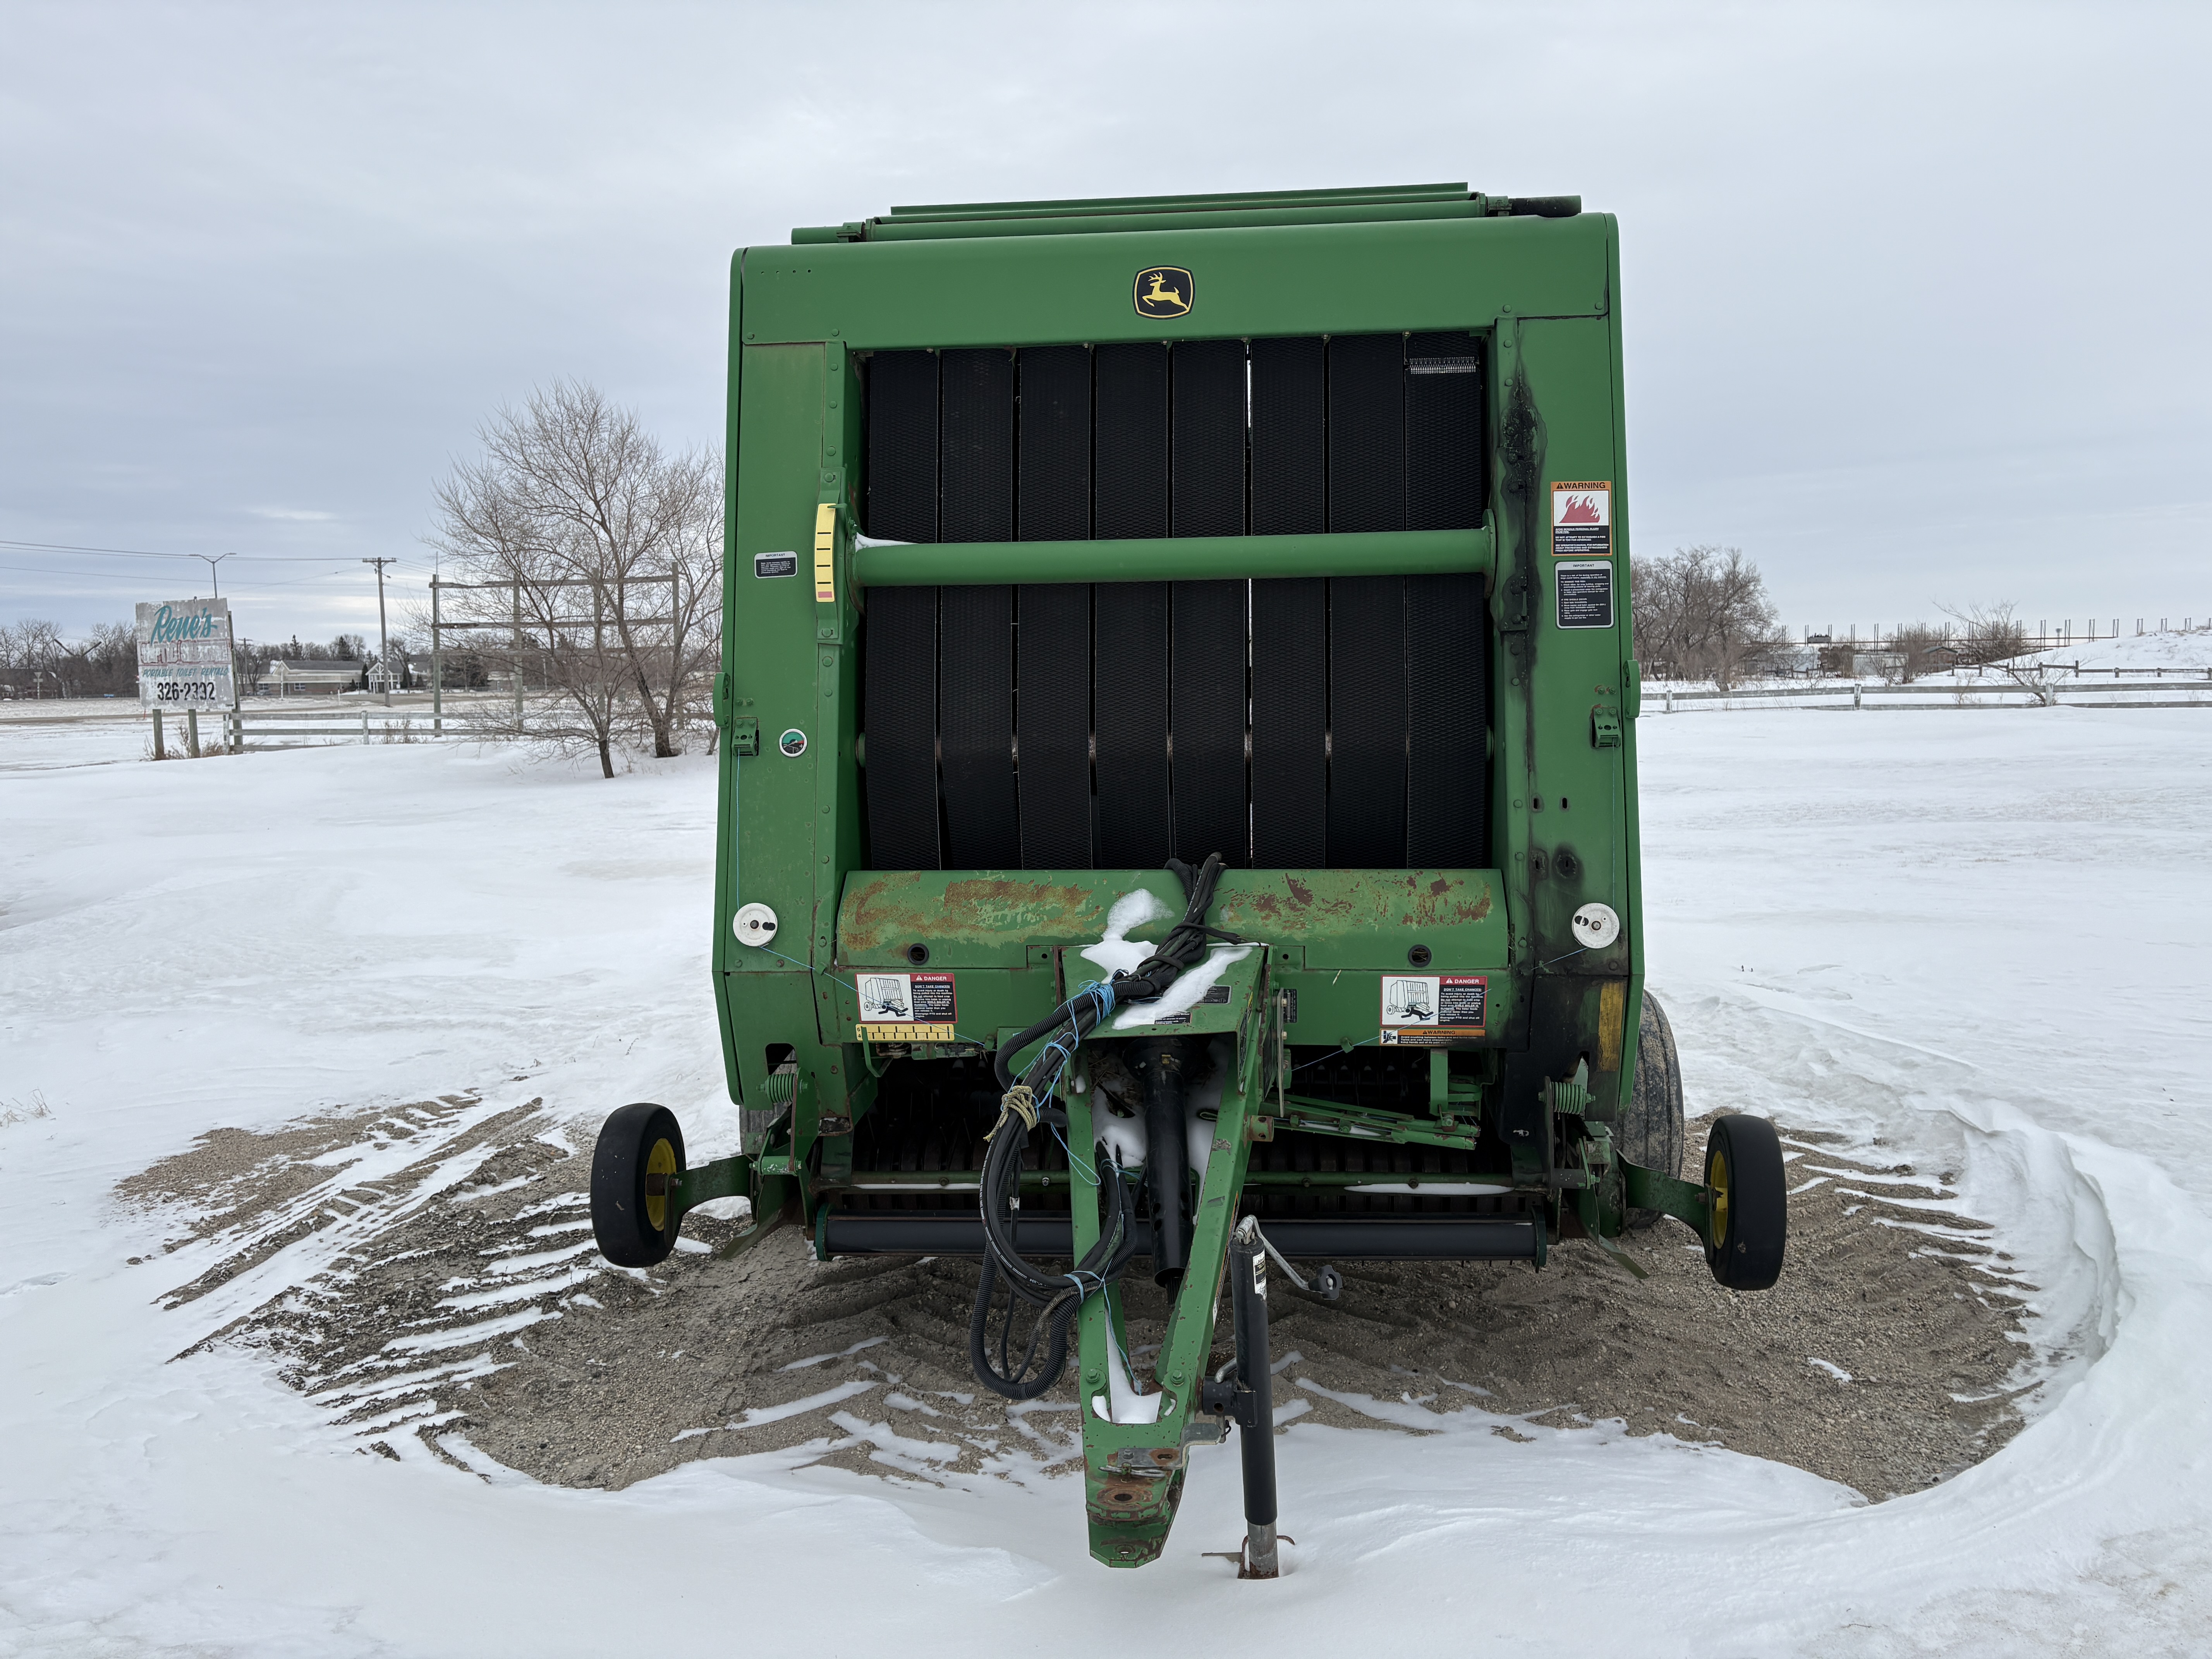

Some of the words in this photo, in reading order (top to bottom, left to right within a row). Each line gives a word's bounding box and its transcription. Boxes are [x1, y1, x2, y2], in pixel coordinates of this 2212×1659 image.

[151, 605, 218, 646] Rene's
[143, 668, 173, 677] PORTABLE
[176, 668, 197, 677] TOILET
[201, 667, 229, 676] RENTALS
[157, 682, 215, 701] 326-2392
